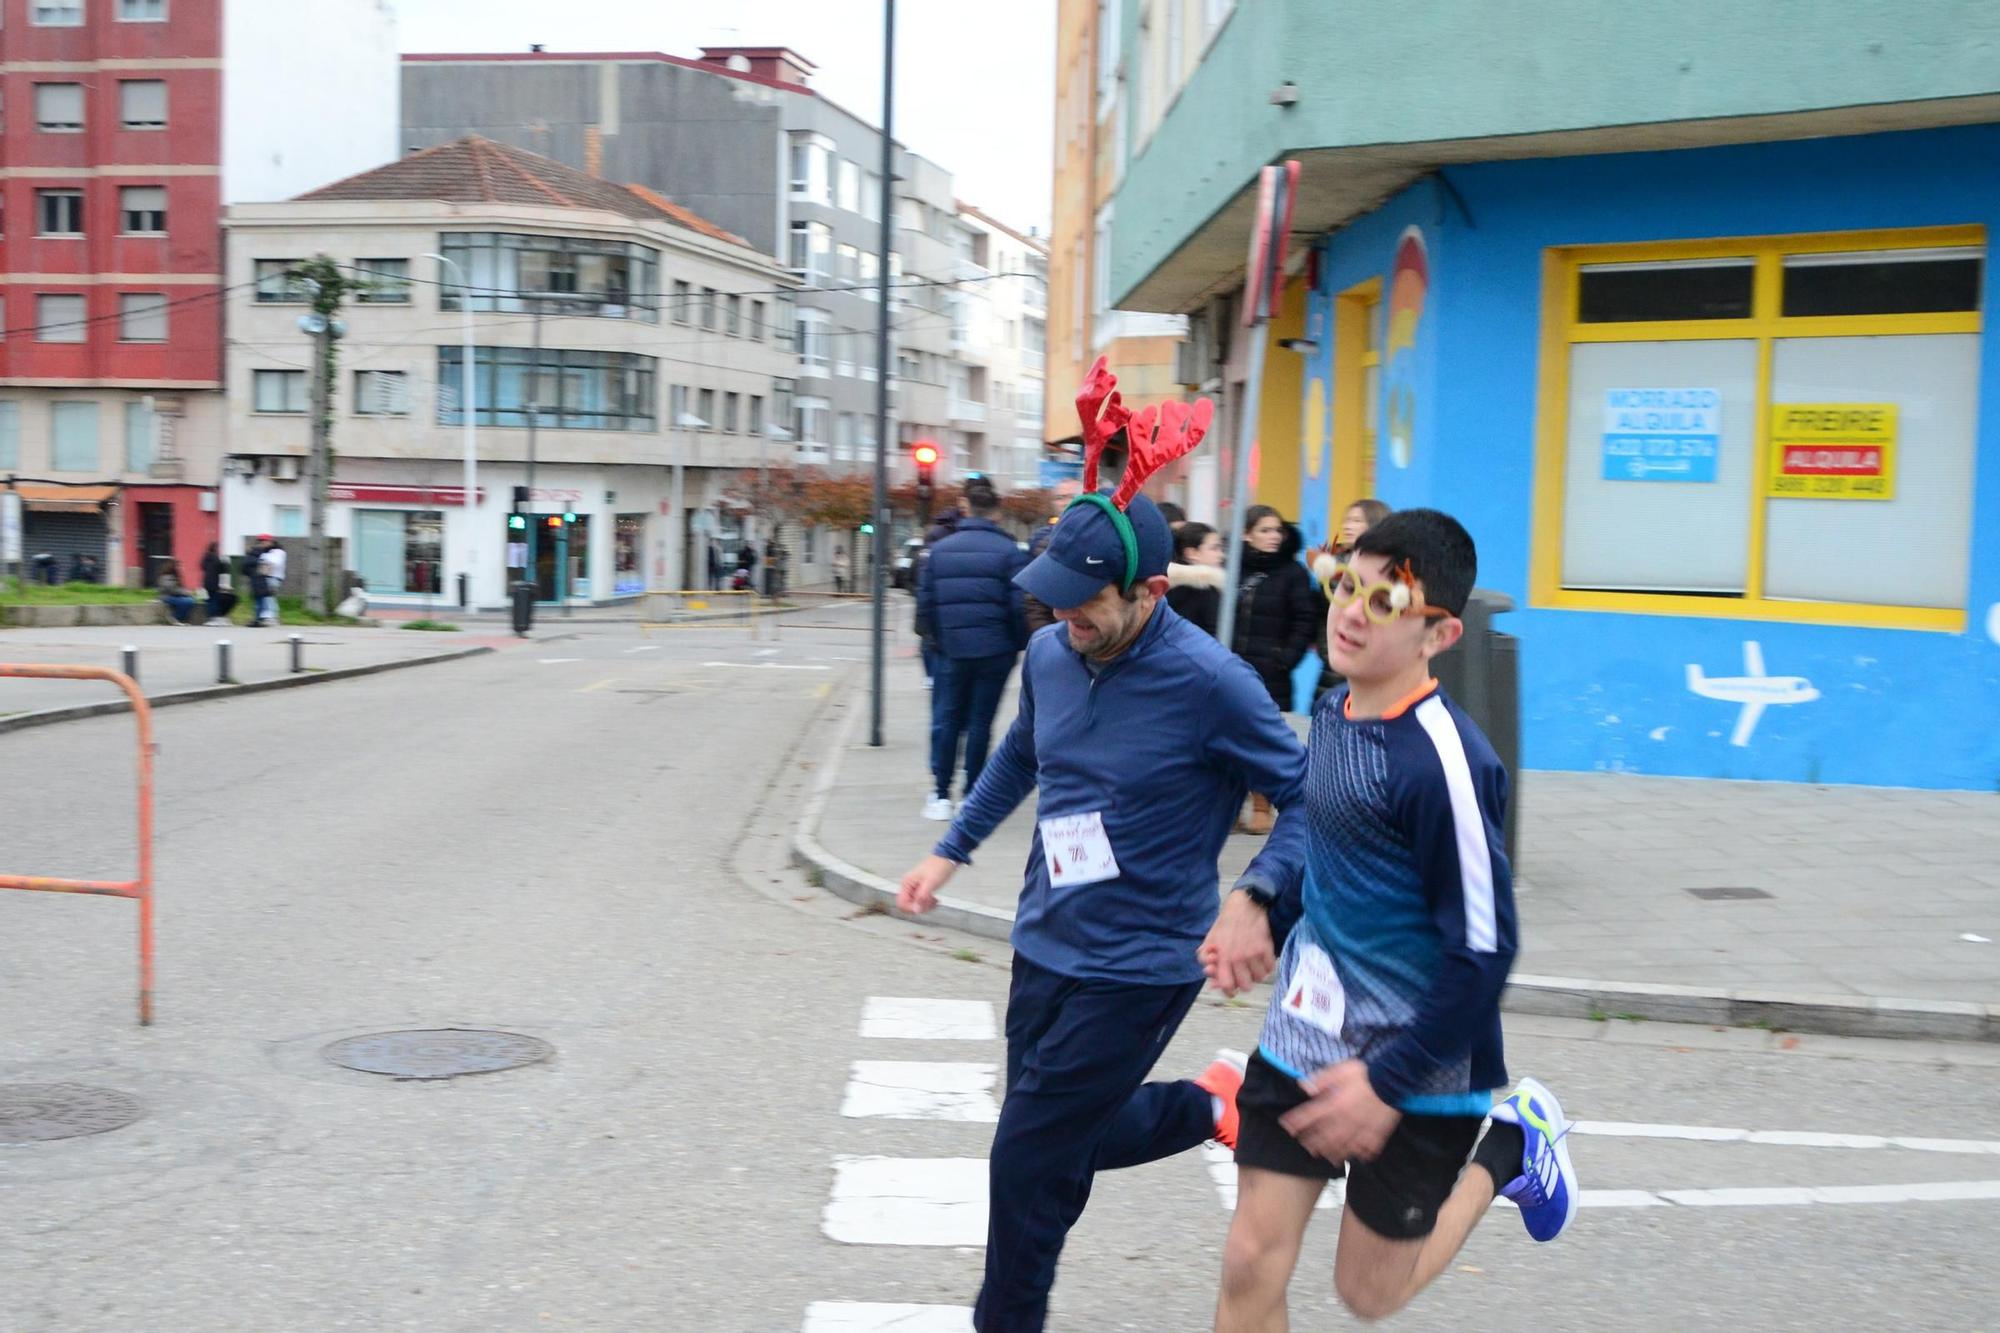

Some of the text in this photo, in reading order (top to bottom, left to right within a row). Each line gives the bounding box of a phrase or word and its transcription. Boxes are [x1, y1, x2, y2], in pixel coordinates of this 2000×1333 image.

[1616, 412, 1706, 430] ALQUILA
[1785, 410, 1885, 431] FREIRE
[1785, 450, 1881, 468] ALQUILA
